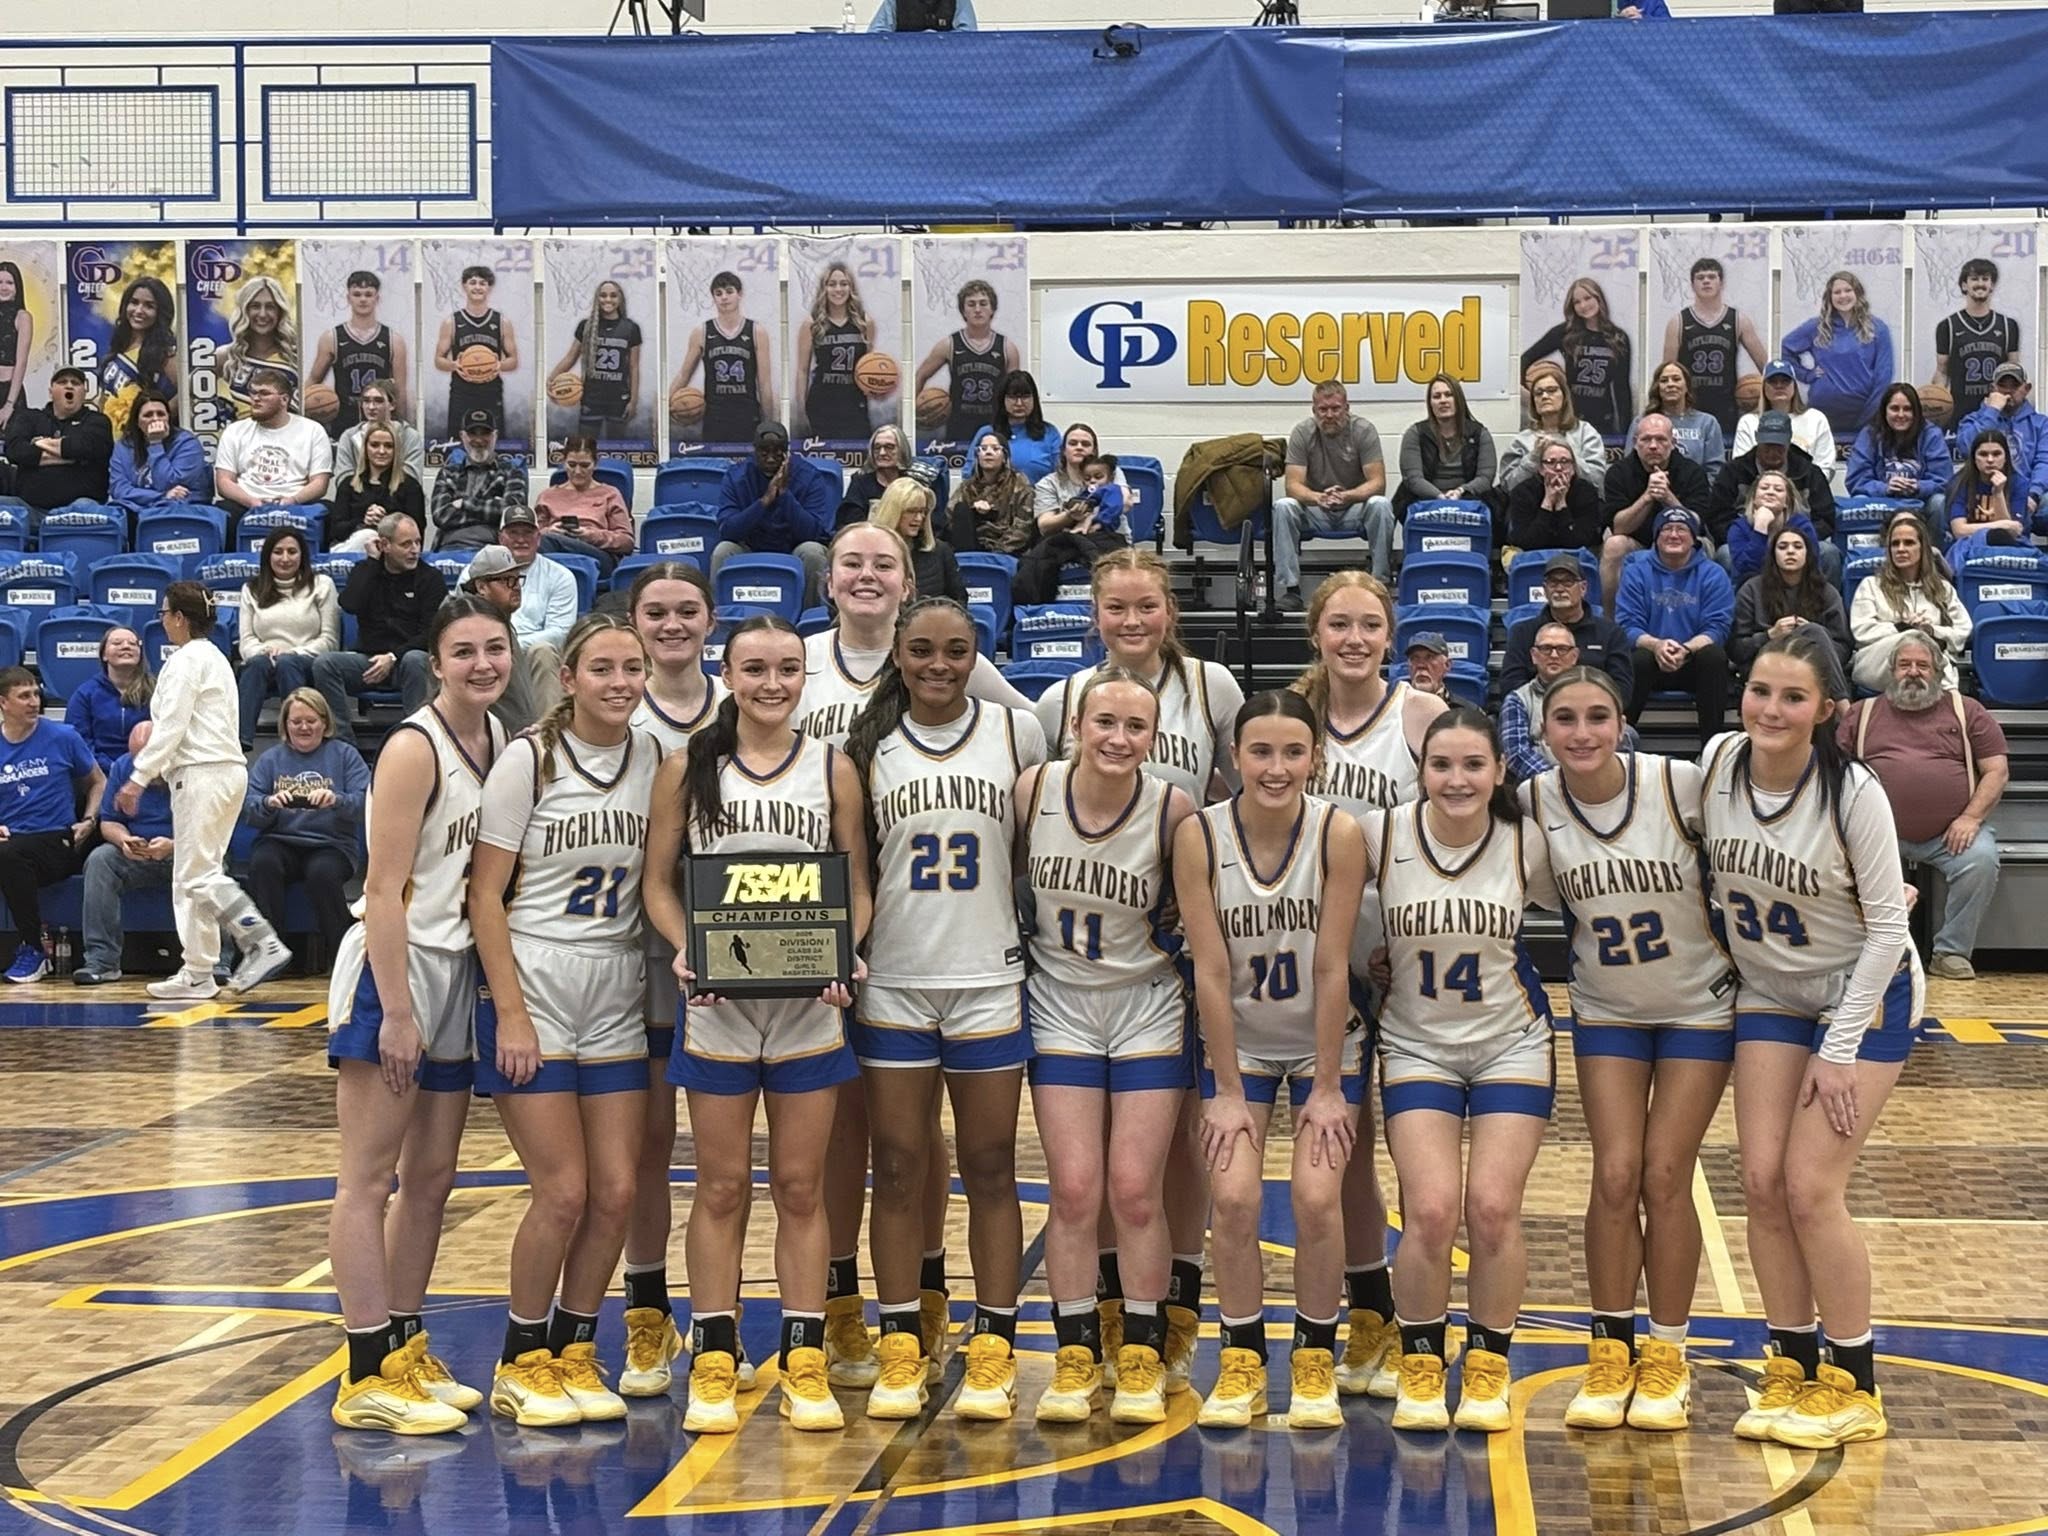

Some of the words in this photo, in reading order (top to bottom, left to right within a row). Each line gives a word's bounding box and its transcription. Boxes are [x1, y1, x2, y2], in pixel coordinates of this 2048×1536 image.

[376, 244, 412, 273] 14
[495, 245, 534, 273] 22
[857, 244, 902, 279] 21
[1724, 231, 1767, 260] 33
[1187, 296, 1481, 386] Reserved
[596, 349, 621, 370] 23
[714, 360, 745, 383] 24
[831, 346, 856, 371] 21
[1577, 359, 1608, 385] 25
[1692, 350, 1725, 374] 33
[1965, 357, 1996, 382] 20
[961, 378, 993, 401] 23
[881, 775, 1006, 833] HIGHLANDERS
[909, 831, 982, 892] 23
[565, 864, 630, 919] 21
[1028, 855, 1150, 910] HIGHLANDERS
[1557, 857, 1684, 904] HIGHLANDERS
[712, 910, 830, 922] CHAMPIONS
[1388, 898, 1516, 940] HIGHLANDERS
[1728, 888, 1810, 948] 34
[779, 938, 824, 947] DIVISION
[1057, 907, 1104, 961] 11
[1590, 909, 1671, 967] 22
[786, 955, 824, 963] DISTRICT
[1249, 951, 1300, 1002] 10
[1418, 948, 1484, 1003] 14
